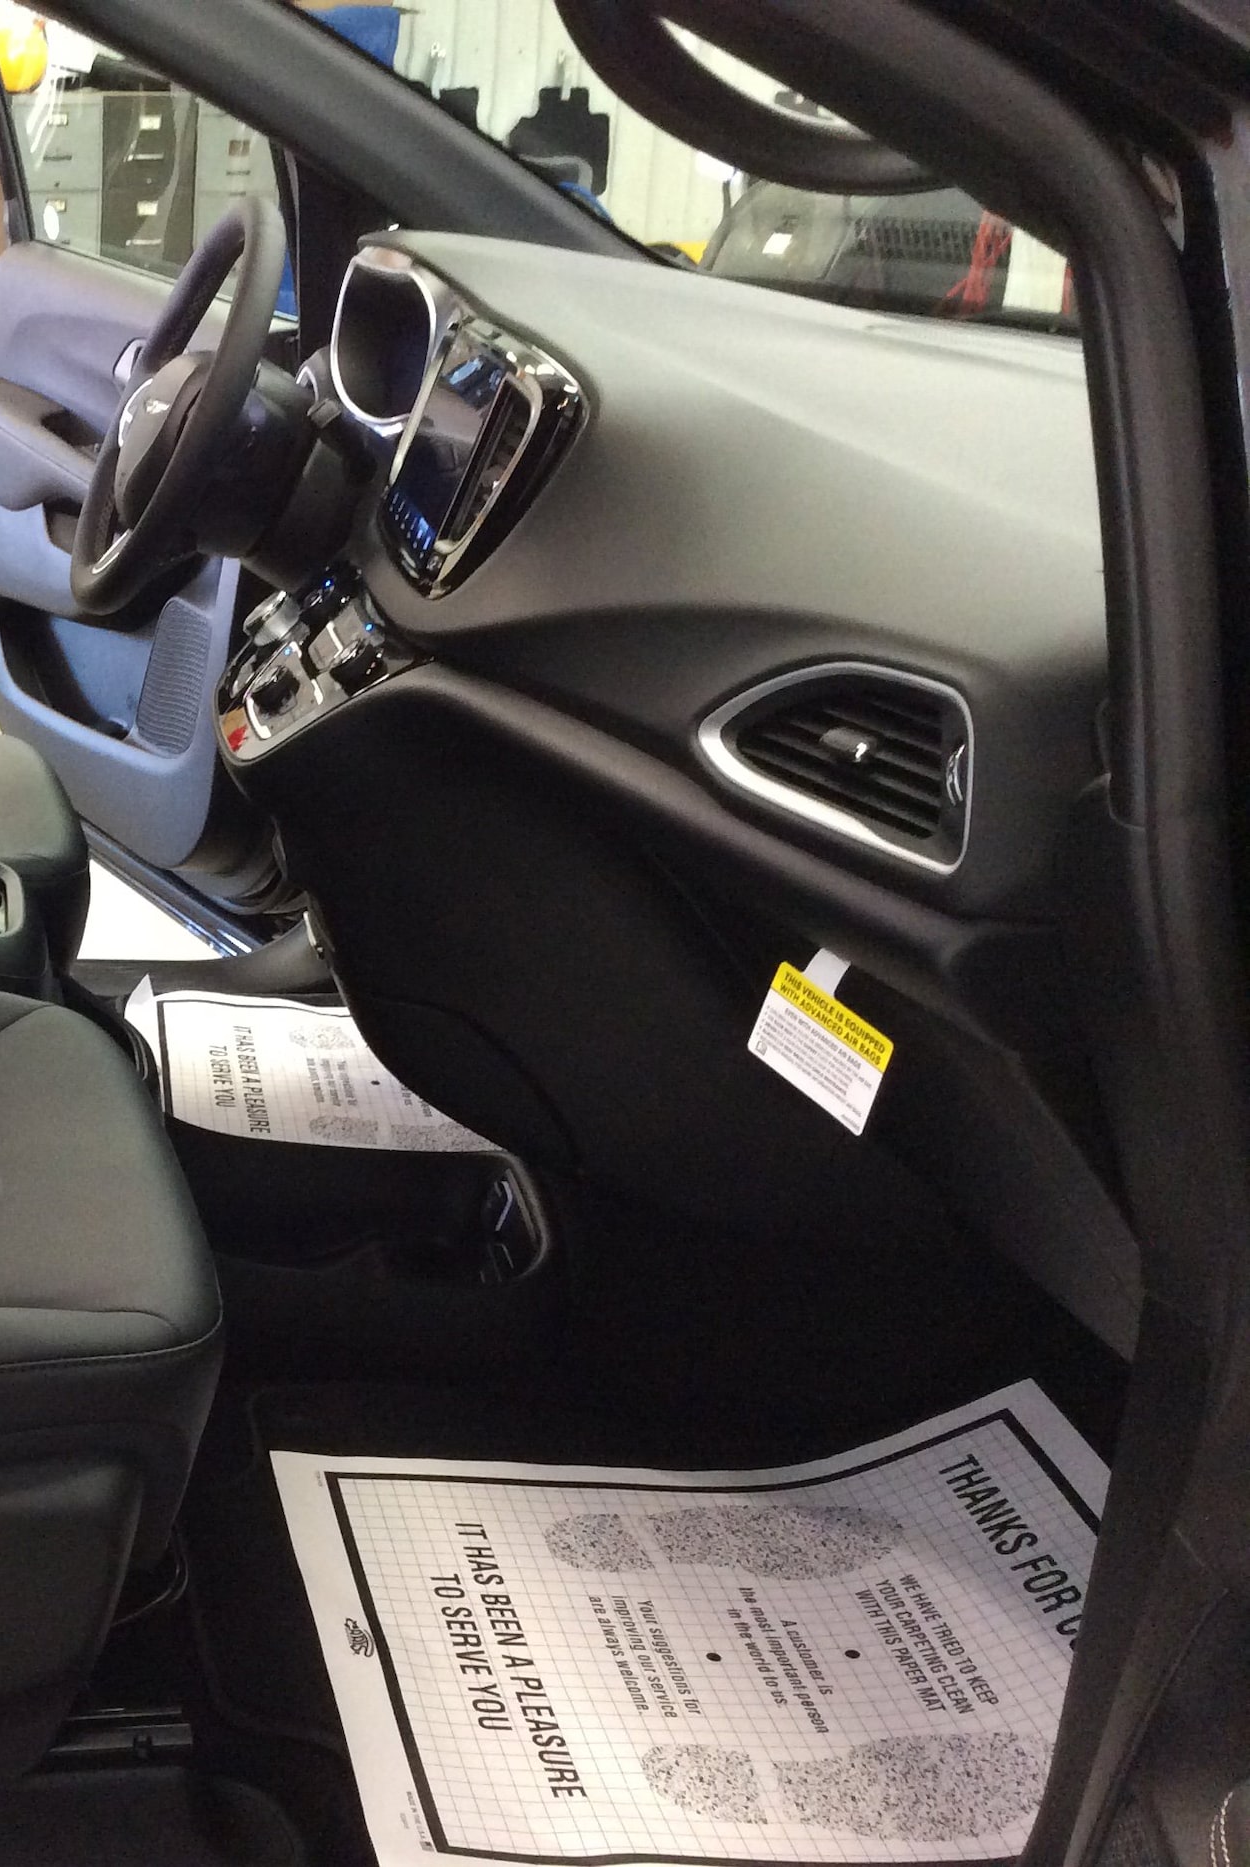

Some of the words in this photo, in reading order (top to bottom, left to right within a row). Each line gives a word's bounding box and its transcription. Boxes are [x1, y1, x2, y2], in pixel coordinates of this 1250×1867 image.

[232, 1025, 252, 1034] IT
[779, 983, 800, 1002] WITH
[799, 1000, 844, 1036] ADVANCED
[843, 1033, 858, 1048] AIR
[858, 1043, 882, 1066] BAGS
[784, 971, 803, 991] THIS
[802, 986, 835, 1016] VEHICLE
[835, 1011, 844, 1022] IS
[844, 1018, 886, 1054] EQUIPPED
[209, 1045, 228, 1057] TO
[235, 1034, 256, 1053] HAS
[210, 1059, 233, 1086] SERVE
[214, 1088, 237, 1107] YOU
[243, 1086, 271, 1134] PLEASURE
[454, 1523, 487, 1540] IT
[939, 1453, 1039, 1555] THANKS
[1010, 1554, 1082, 1614] FOR
[430, 1573, 466, 1600] TO
[463, 1546, 504, 1586] HAS
[480, 1593, 527, 1647] BEEN
[589, 1596, 606, 1614] are
[780, 1619, 797, 1628] A
[441, 1606, 494, 1676] SERVE
[501, 1654, 534, 1668] A
[597, 1617, 625, 1657] always
[611, 1595, 646, 1651] improving
[637, 1654, 656, 1673] our
[648, 1676, 678, 1718] service
[638, 1600, 658, 1624] Your
[649, 1628, 691, 1695] suggestions
[683, 1698, 701, 1715] for
[726, 1608, 742, 1619] in
[734, 1622, 752, 1639] the
[745, 1641, 775, 1673] world
[763, 1676, 779, 1688] to
[771, 1690, 788, 1709] us.
[738, 1587, 757, 1604] the
[749, 1606, 776, 1632] most
[765, 1636, 807, 1690] important
[793, 1692, 829, 1734] person
[787, 1629, 825, 1681] customer
[855, 1589, 886, 1618] WITH
[874, 1618, 902, 1646] THIS
[891, 1647, 927, 1685] PAPER
[916, 1686, 946, 1712] MAT
[875, 1579, 906, 1610] YOUR
[895, 1610, 948, 1674] CARPETING
[937, 1674, 975, 1714] CLEAN
[899, 1574, 921, 1592] WE
[910, 1592, 942, 1622] HAVE
[932, 1622, 965, 1657] TRIED
[955, 1656, 977, 1675] TO
[966, 1675, 999, 1705] KEEP
[467, 1683, 513, 1731] YOU
[616, 1660, 650, 1716] welcome.
[817, 1685, 833, 1696] is
[510, 1676, 588, 1798] PLEASURE
